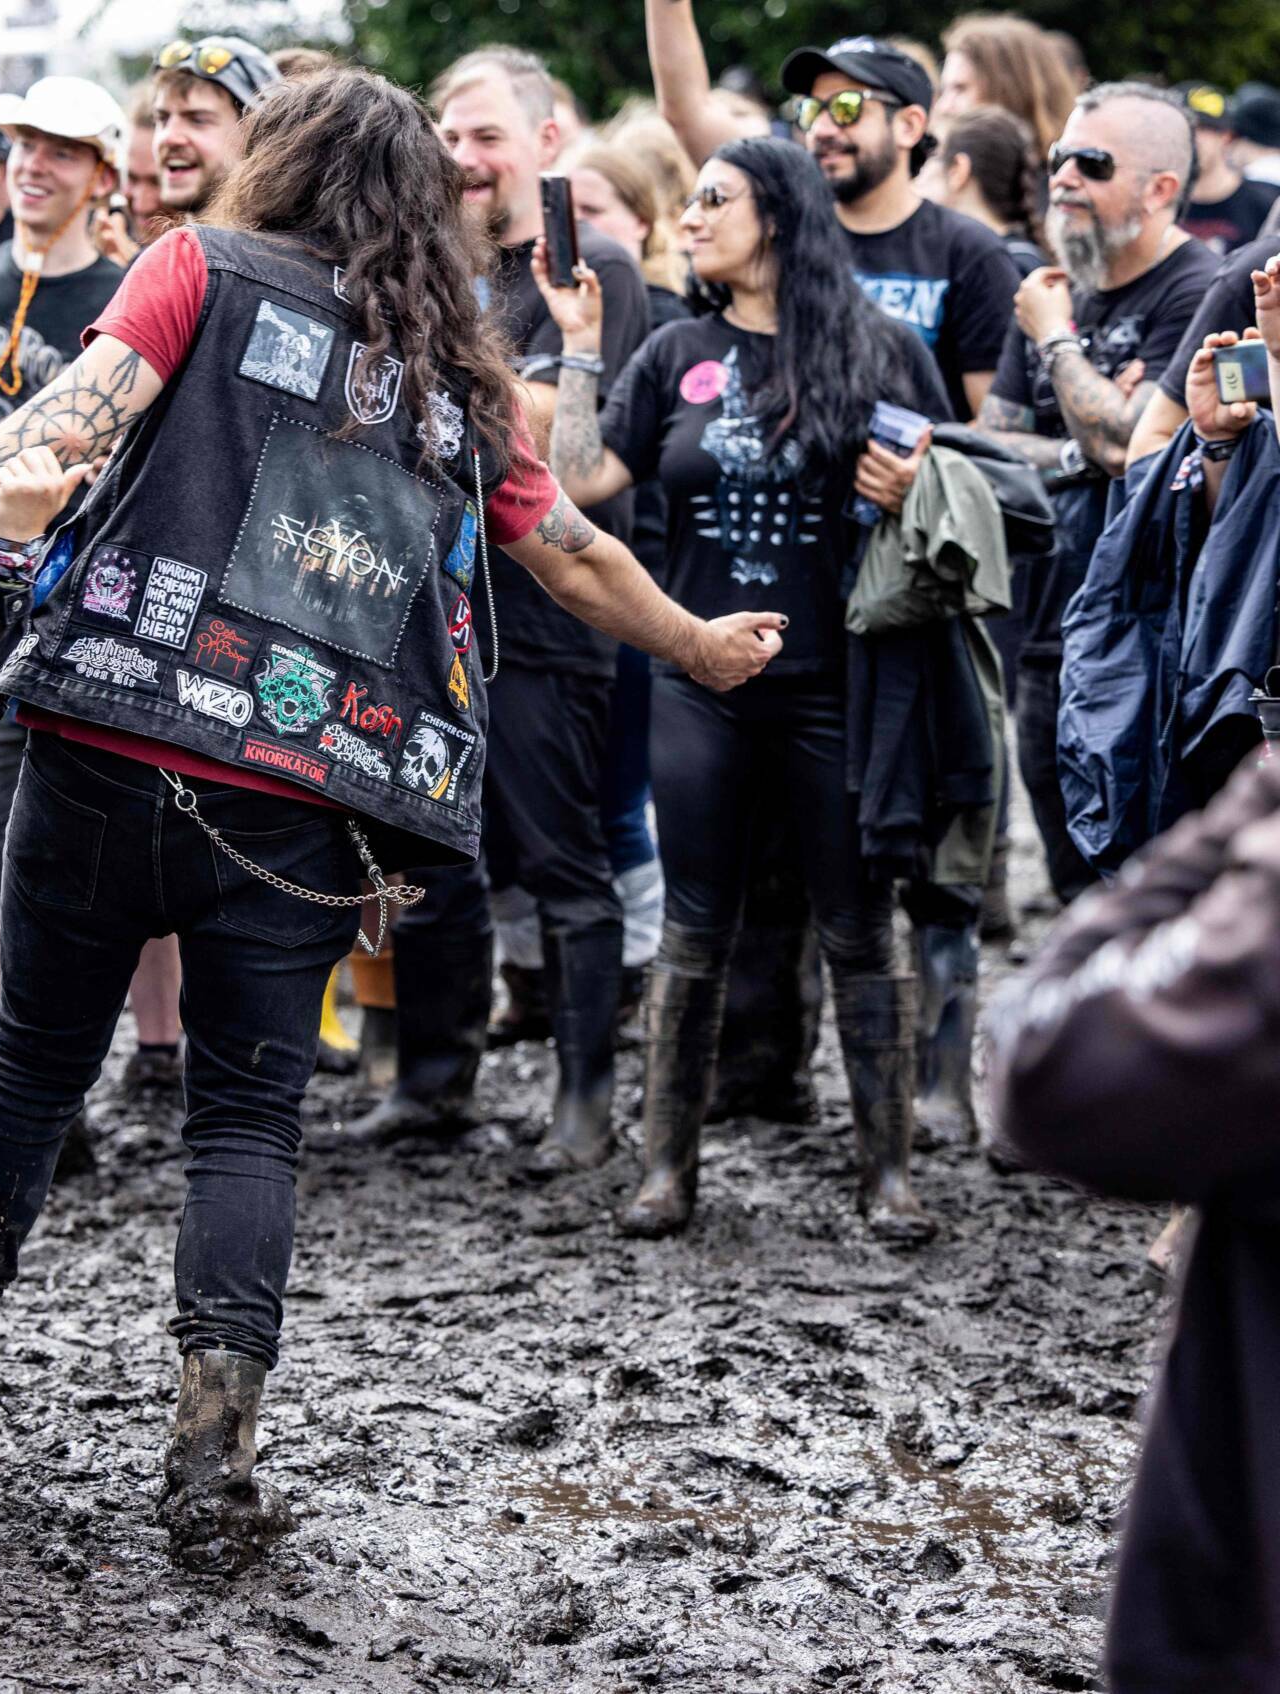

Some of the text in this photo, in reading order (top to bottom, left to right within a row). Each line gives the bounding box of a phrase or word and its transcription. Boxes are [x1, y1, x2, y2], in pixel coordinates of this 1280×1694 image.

[149, 573, 202, 598] SCHENKT
[157, 561, 200, 585] WARUM
[101, 604, 126, 616] NAZIS
[147, 586, 167, 605] IHR
[167, 595, 195, 613] MIR
[146, 602, 186, 625] KEIN
[139, 617, 185, 643] BIER?
[271, 644, 337, 679] SUMMER BREEZE
[75, 662, 137, 688] Open Air
[176, 669, 254, 728] WIZO
[245, 745, 324, 784] KNORKATOR
[446, 745, 472, 800] SUPPORTER
